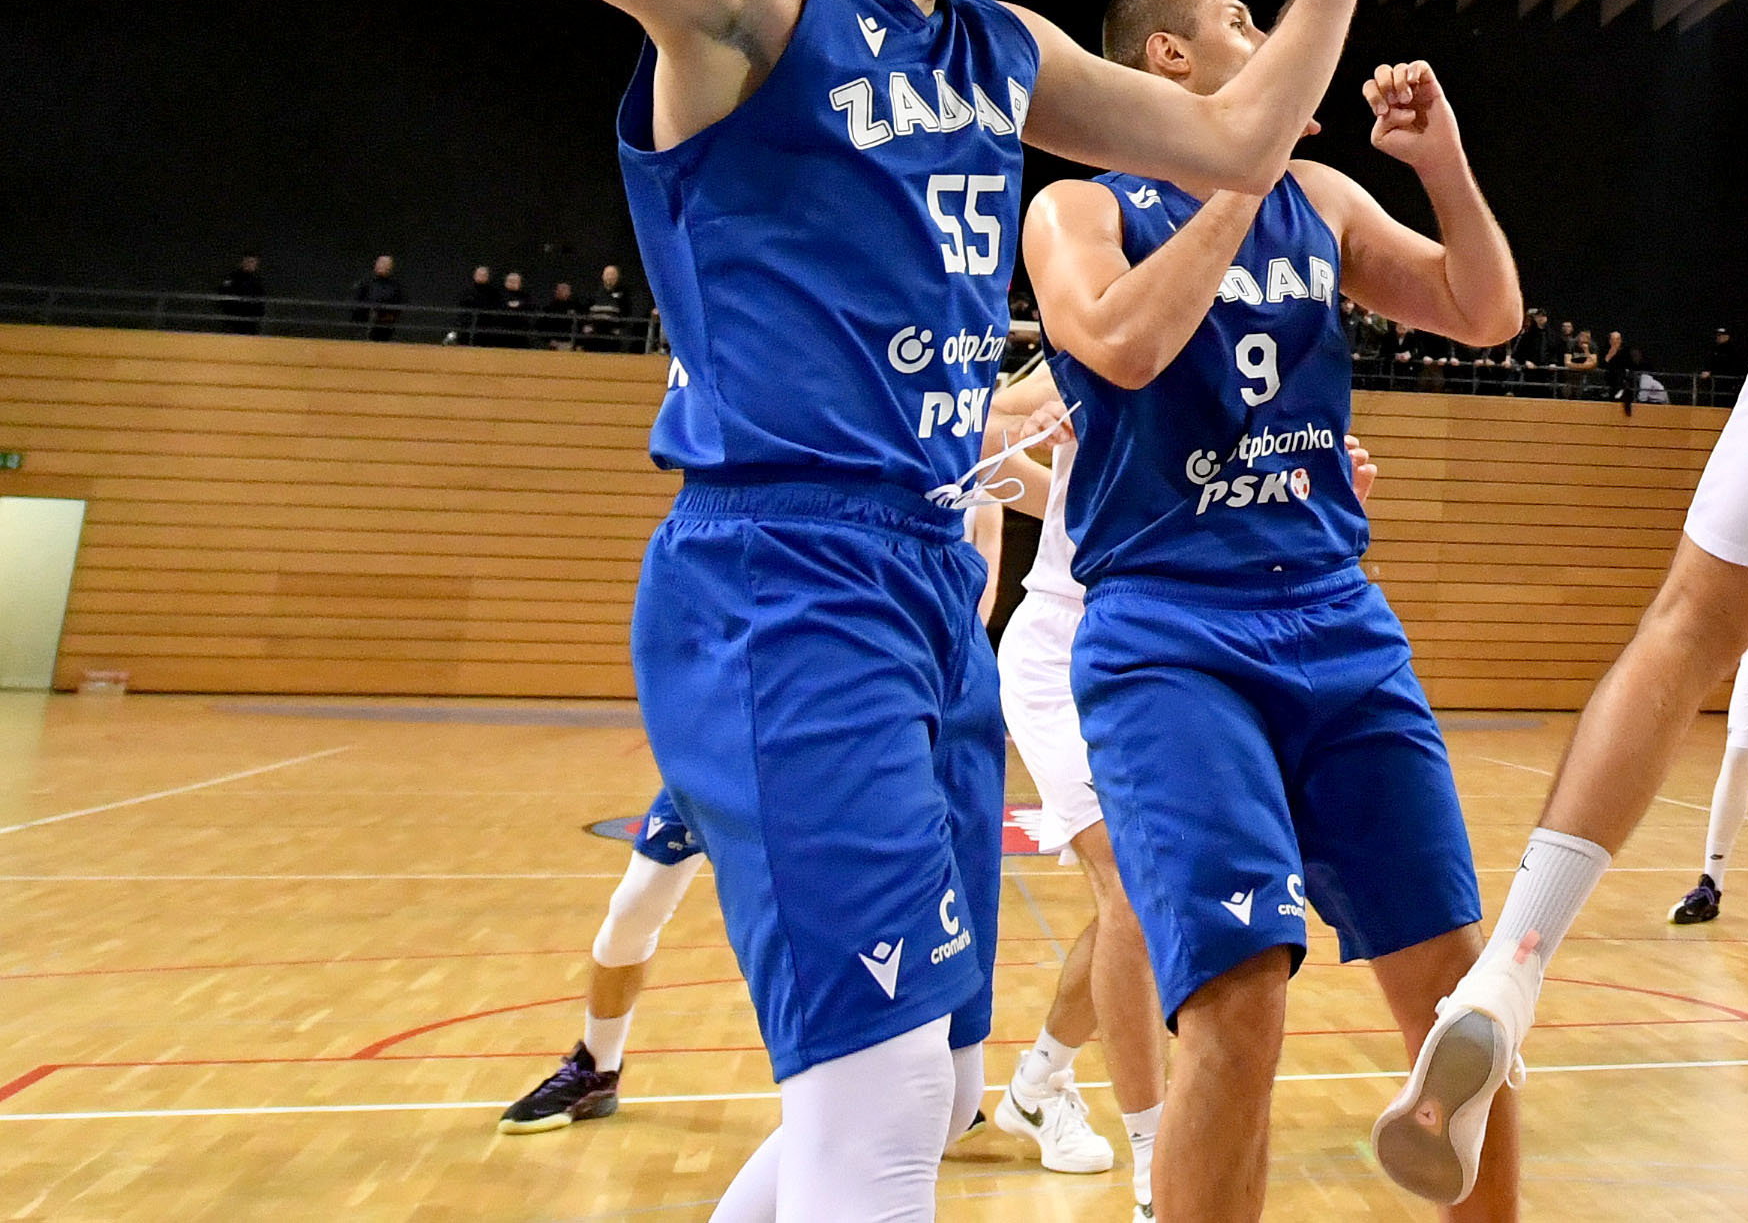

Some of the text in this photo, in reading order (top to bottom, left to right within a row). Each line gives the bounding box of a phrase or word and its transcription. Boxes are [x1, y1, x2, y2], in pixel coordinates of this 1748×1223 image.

[927, 175, 1005, 275] 55
[1236, 333, 1280, 406] 9
[1196, 470, 1289, 516] PSK
